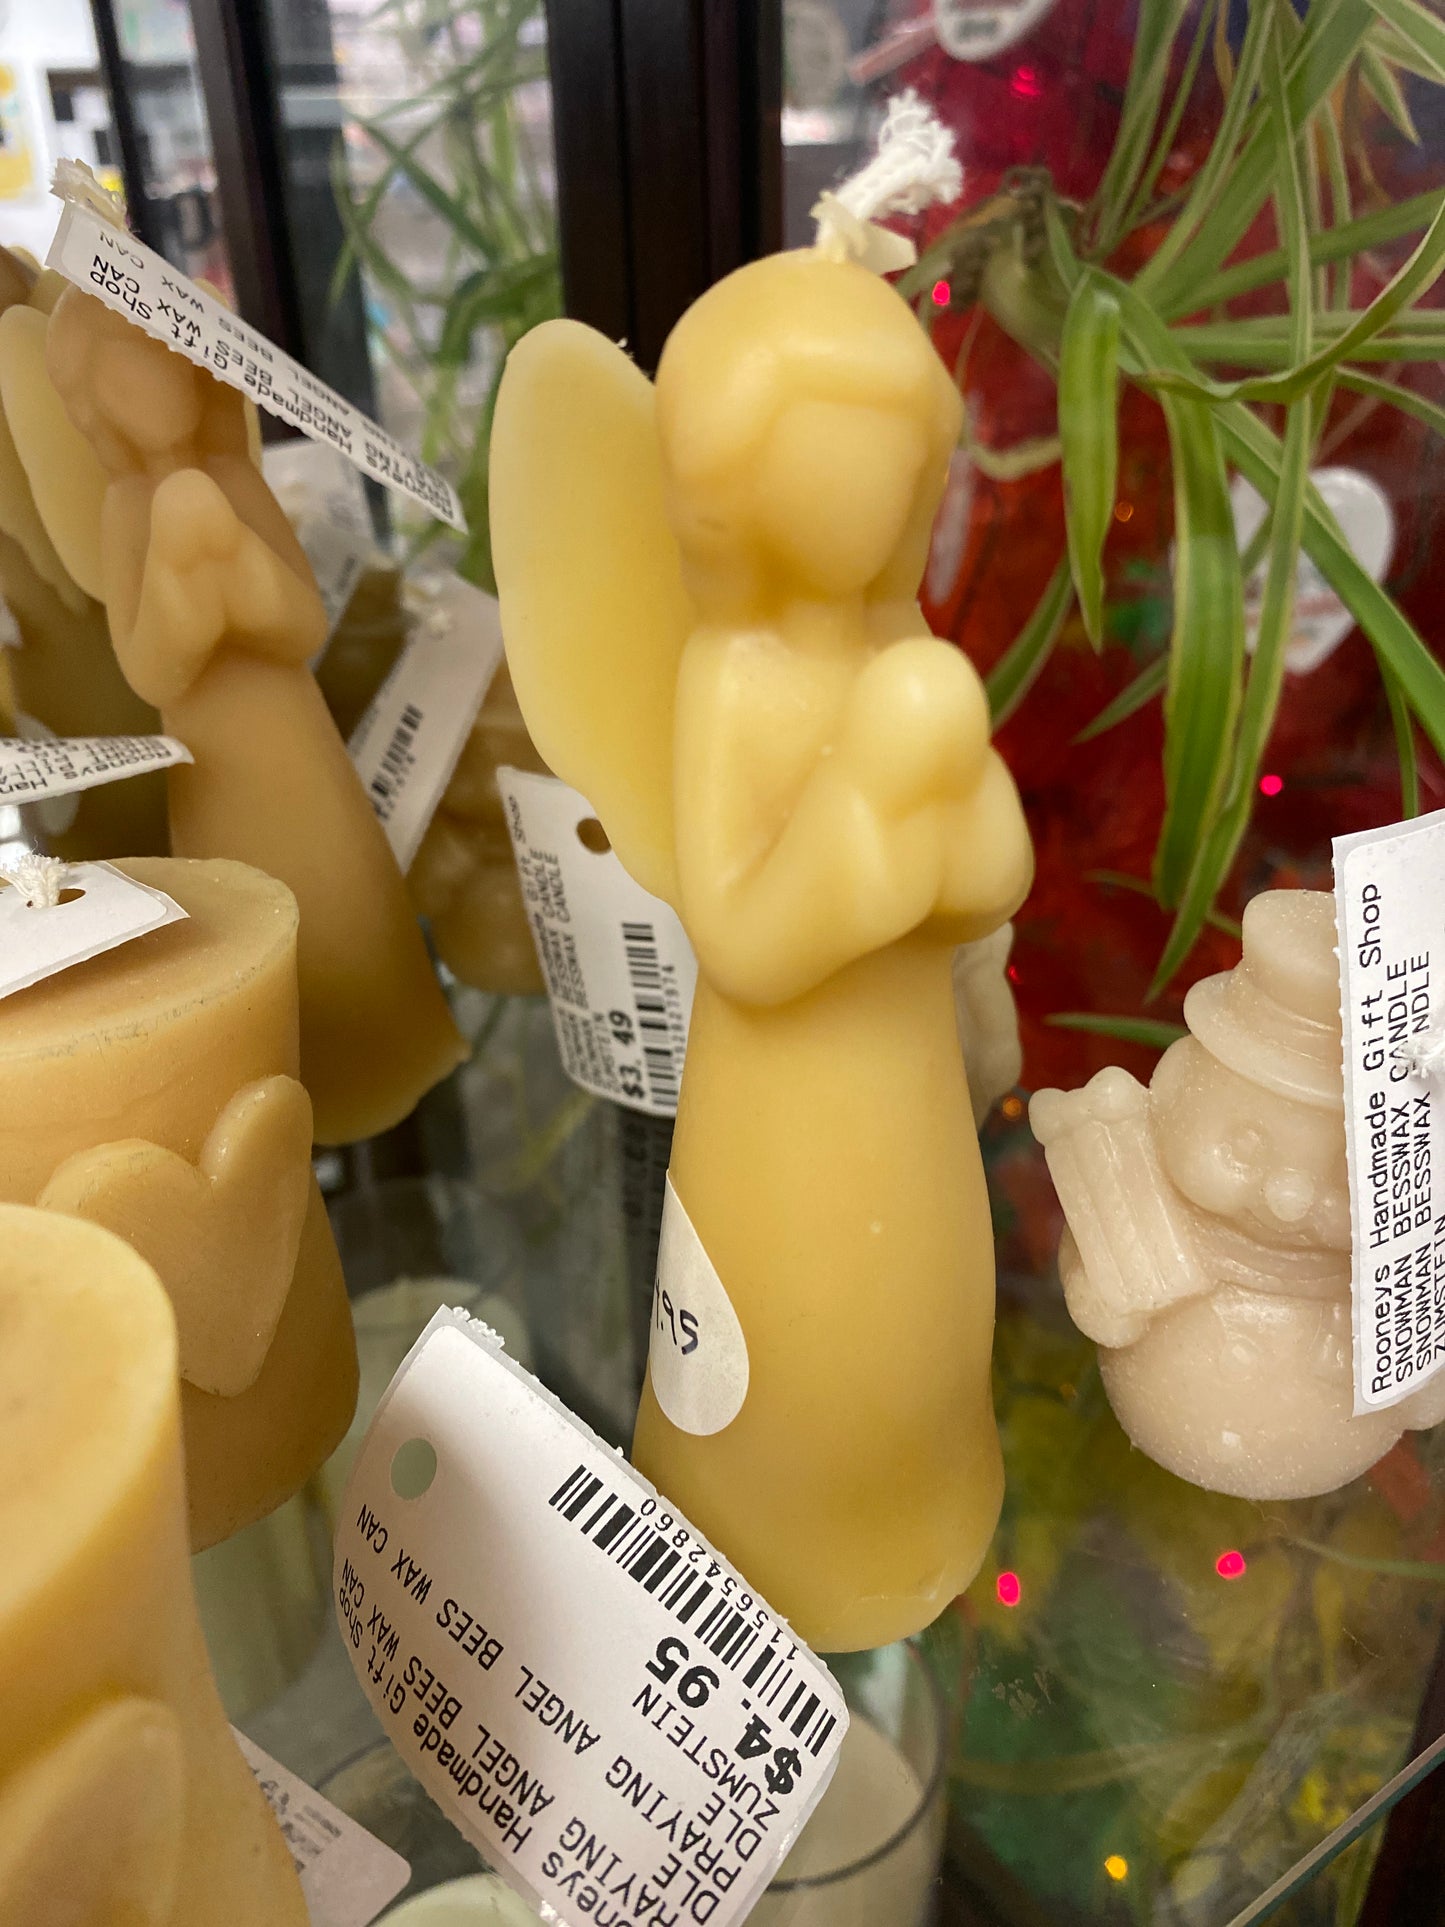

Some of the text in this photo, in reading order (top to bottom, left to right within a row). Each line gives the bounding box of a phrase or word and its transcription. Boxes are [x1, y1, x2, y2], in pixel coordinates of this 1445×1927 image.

[93, 255, 140, 294] CAN
[100, 231, 144, 270] CAN
[90, 270, 152, 320] Shop
[156, 298, 201, 338] WAX
[161, 275, 204, 314] WAX
[171, 323, 227, 370] Gift
[216, 340, 272, 386] BEES
[218, 317, 273, 363] BEES
[244, 373, 352, 454] Handmade
[288, 387, 352, 438] ANGEL
[0, 777, 48, 795] Han
[63, 750, 173, 780] Rooneys
[544, 850, 571, 923] CANDLE
[1357, 883, 1393, 1394] Rooneys Handmade Gift Shop
[1391, 1100, 1411, 1240] BESSWAX
[1411, 951, 1432, 1372] SNOWMAN BESSWAX NDLE
[1394, 1253, 1413, 1385] SNOWMAN
[640, 1498, 799, 1661] 1156542860
[357, 1504, 741, 1892] PRAYING ANGEL BEES WAX CAN
[645, 1636, 802, 1796] $4.95
[339, 1588, 632, 1927] neys Handmade Gift Shop
[343, 1558, 679, 1927] RAYING ANGEL BEES WAX CAN
[632, 1683, 780, 1831] ZUMSTEIN
[697, 1792, 762, 1862] DLE
[652, 1853, 720, 1926] DLE
